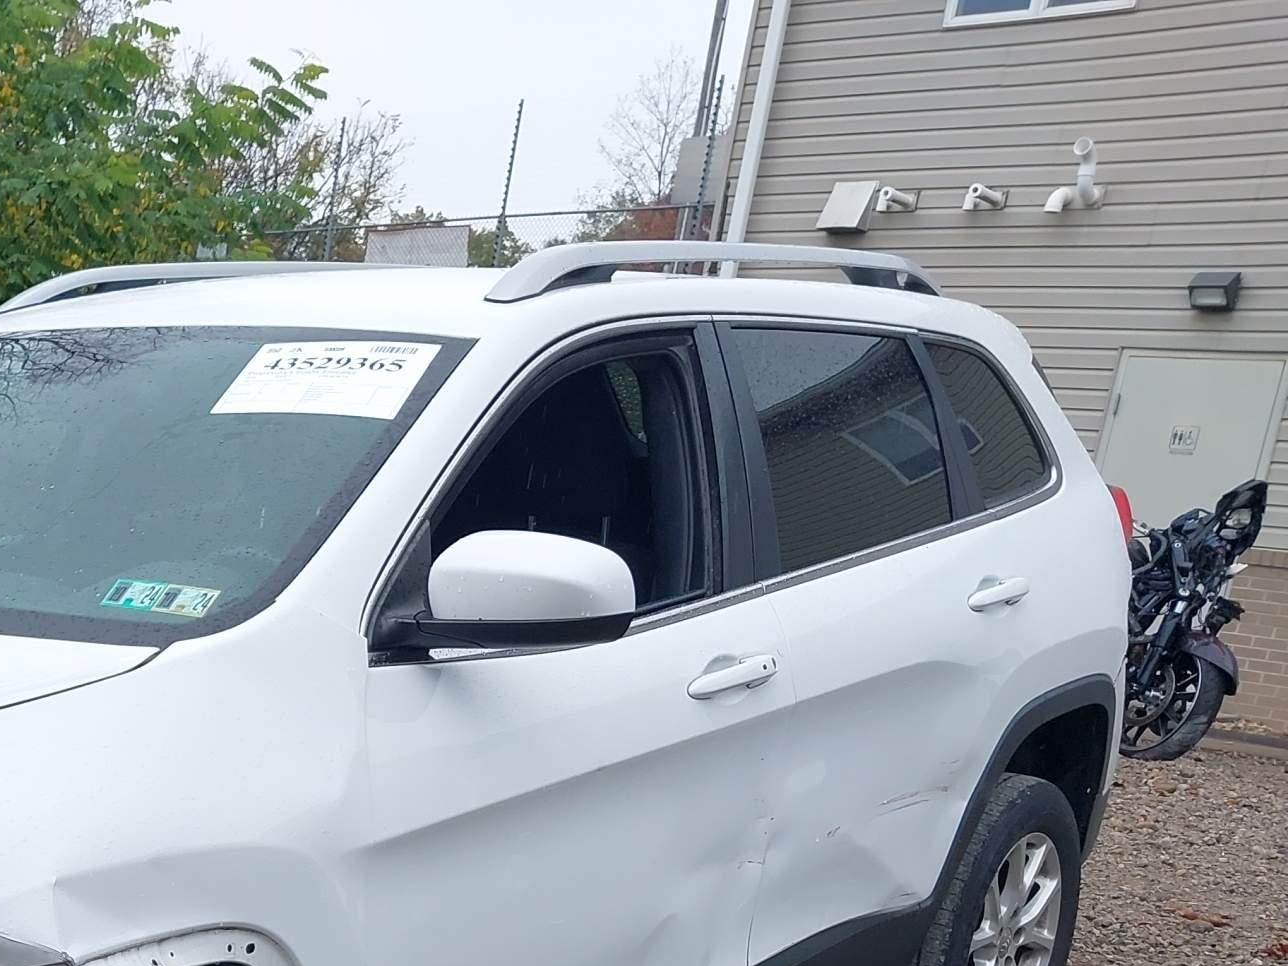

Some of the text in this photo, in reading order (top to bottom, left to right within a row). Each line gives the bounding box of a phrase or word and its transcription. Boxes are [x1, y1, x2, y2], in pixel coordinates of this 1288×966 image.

[264, 357, 407, 372] 43529365
[140, 585, 162, 605] 24
[192, 593, 215, 614] 24
